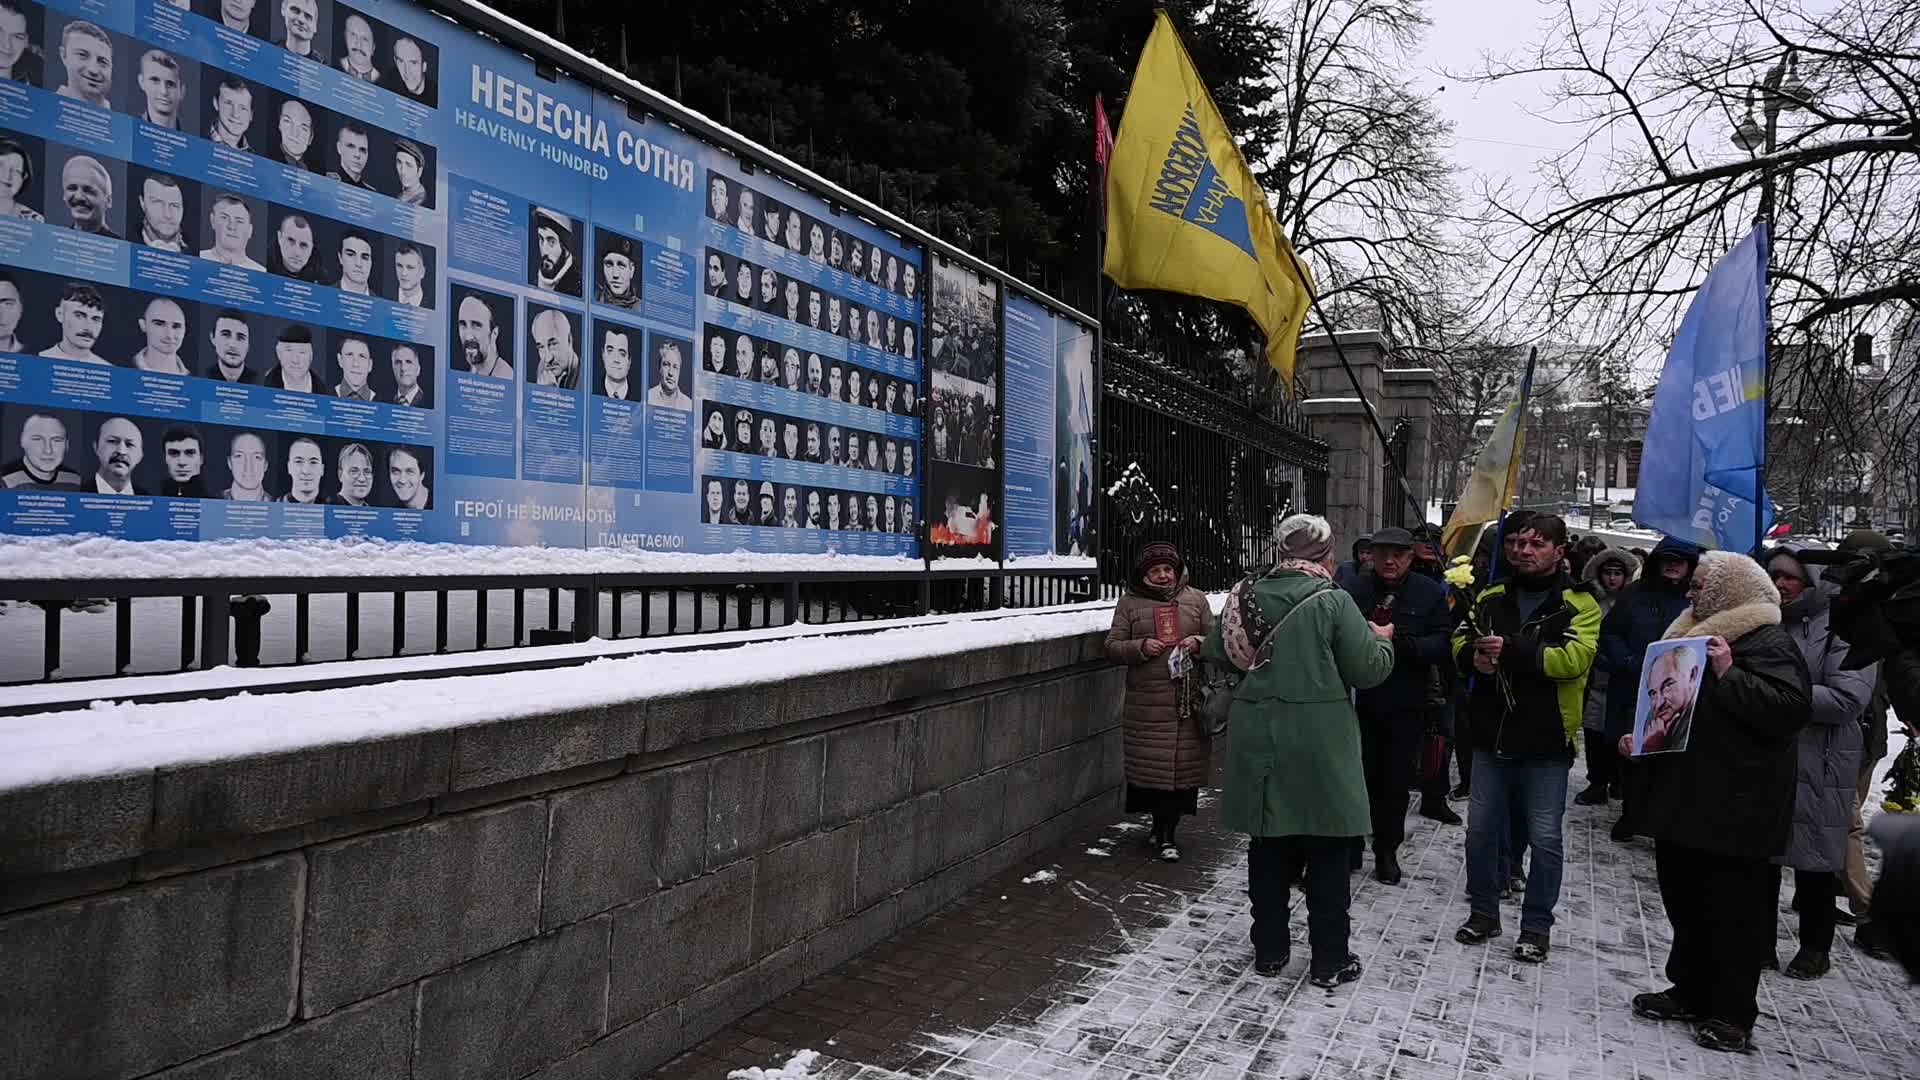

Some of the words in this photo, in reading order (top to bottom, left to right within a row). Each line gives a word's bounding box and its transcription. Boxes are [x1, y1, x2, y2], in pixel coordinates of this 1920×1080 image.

[455, 107, 538, 153] HEAVENLY
[540, 141, 609, 182] HUNDRED
[471, 64, 611, 158] НЕБЕСНА
[616, 130, 695, 193] СОТНЯ
[454, 499, 504, 519] ГЕРОЇ
[506, 503, 528, 521] НЕ
[531, 504, 617, 524] ВМИРАЮТЬ!
